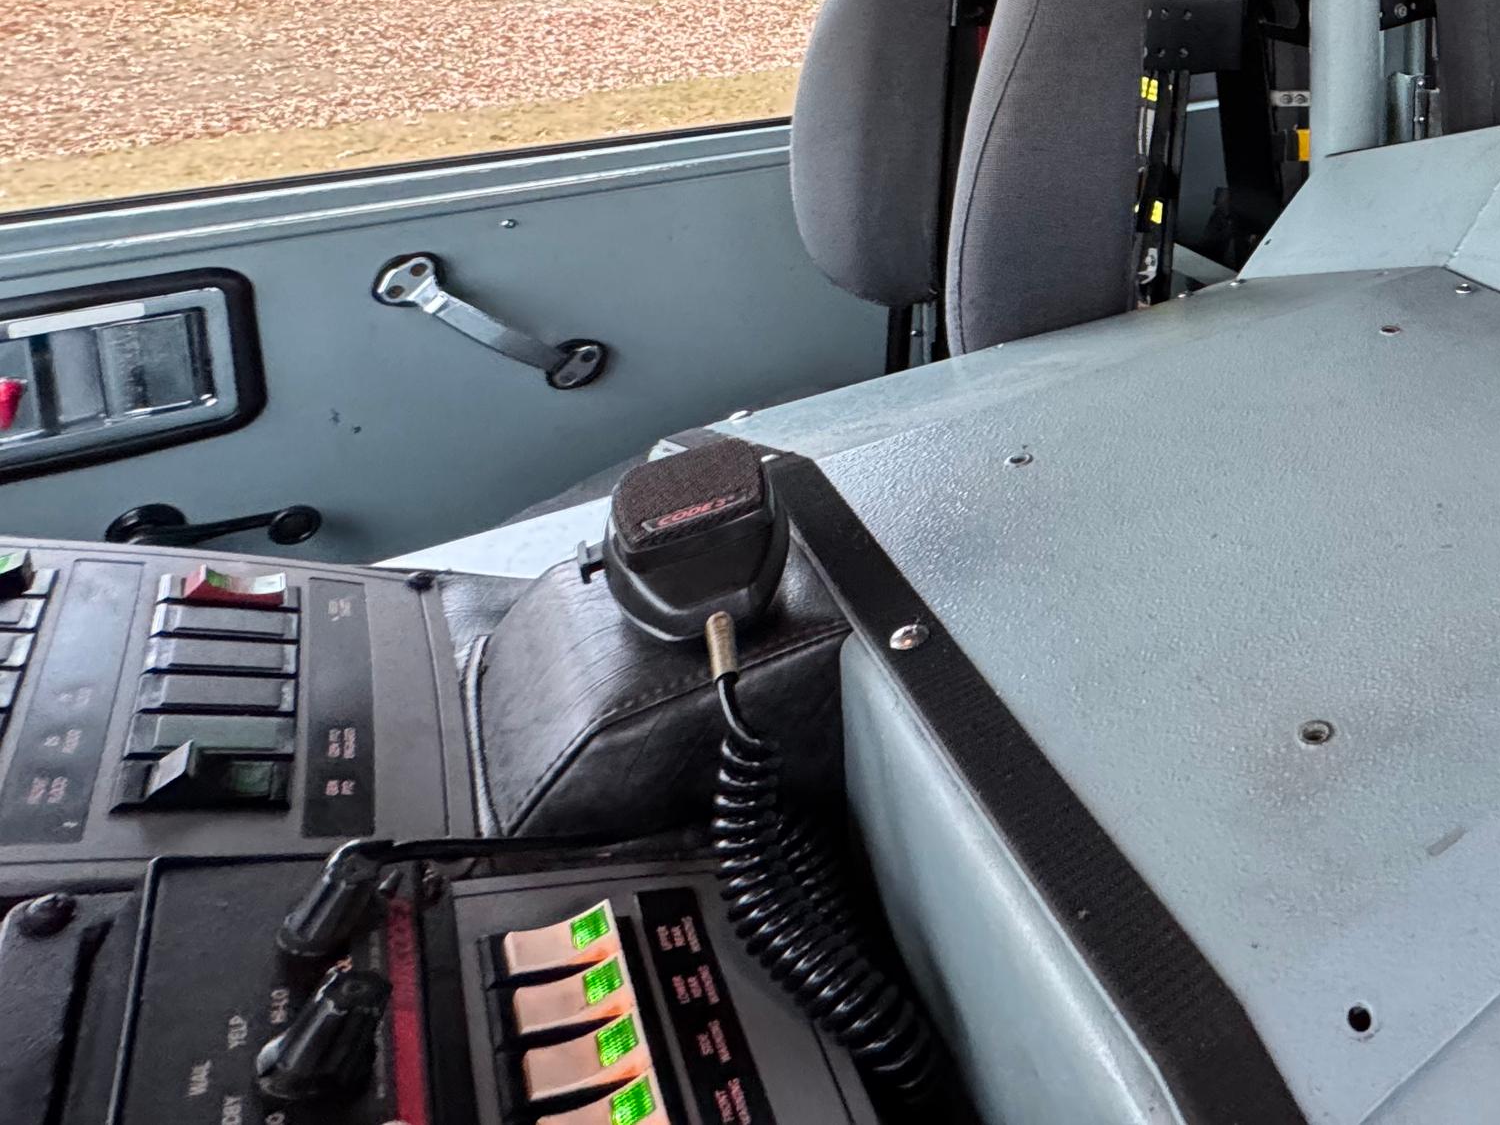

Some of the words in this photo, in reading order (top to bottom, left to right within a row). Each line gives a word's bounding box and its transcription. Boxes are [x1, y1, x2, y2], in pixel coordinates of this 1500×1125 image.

[657, 503, 711, 526] CODE
[227, 1015, 248, 1050] YELP
[221, 1095, 243, 1125] DBY
[715, 1089, 735, 1123] FRONT
